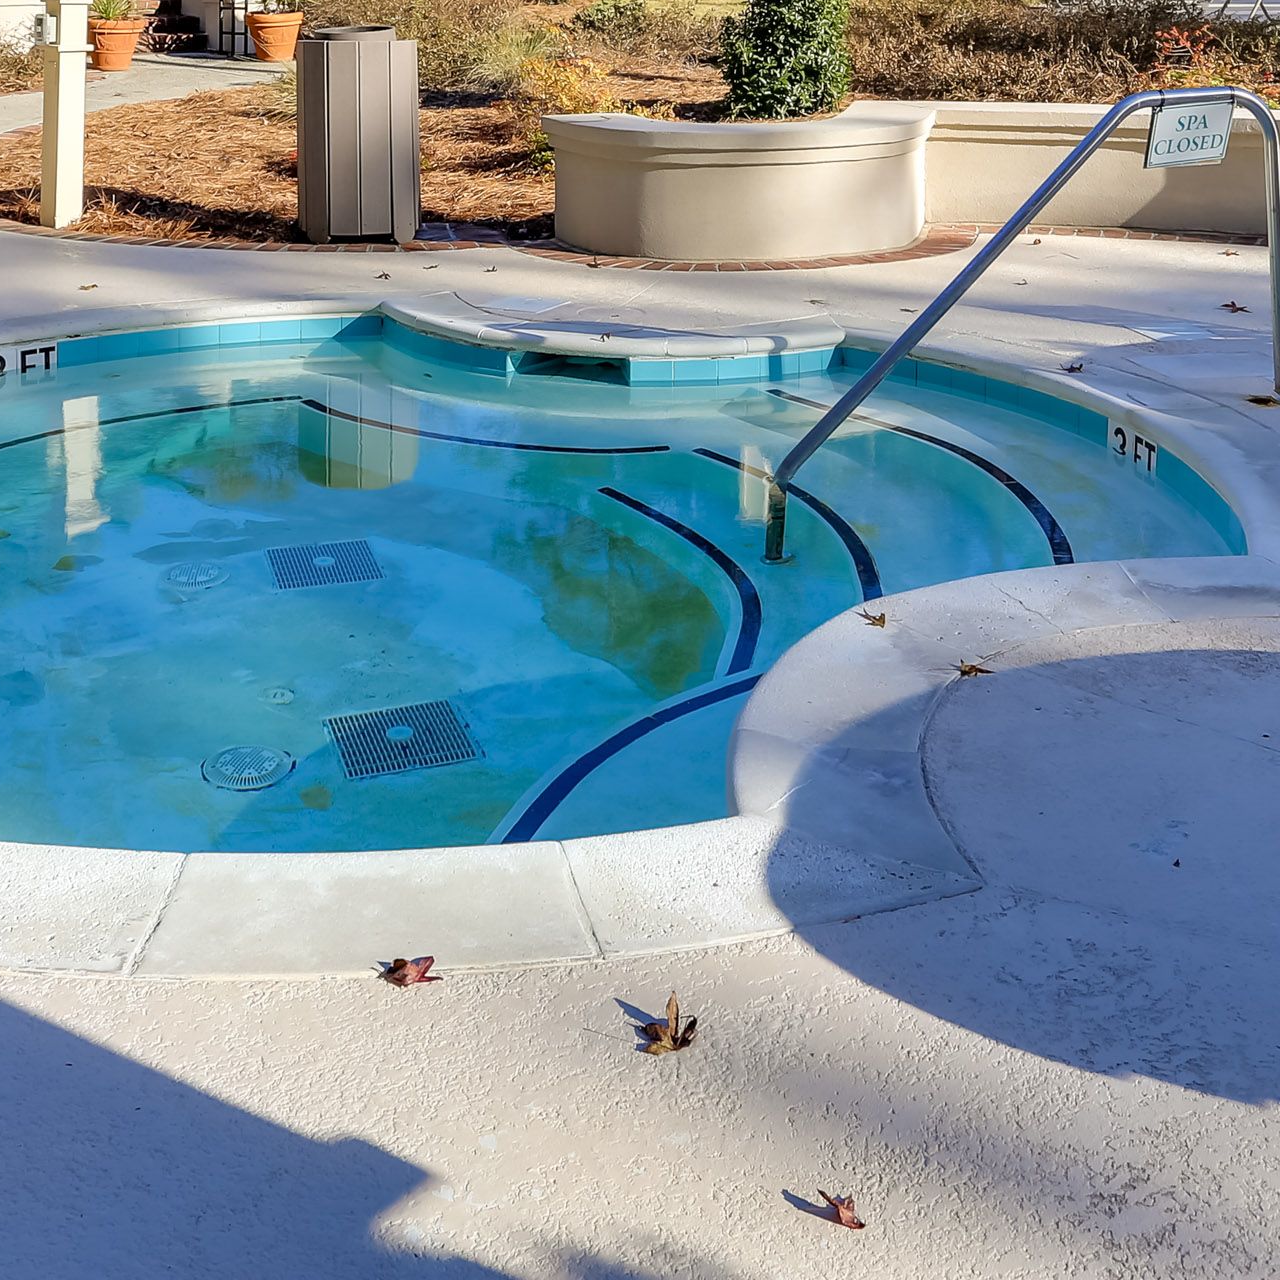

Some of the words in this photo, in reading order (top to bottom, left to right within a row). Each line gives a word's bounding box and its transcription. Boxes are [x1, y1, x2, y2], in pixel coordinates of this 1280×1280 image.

[1175, 114, 1209, 132] SPA
[1154, 133, 1224, 156] CLOSED
[20, 345, 56, 374] FT
[1133, 434, 1156, 472] FT
